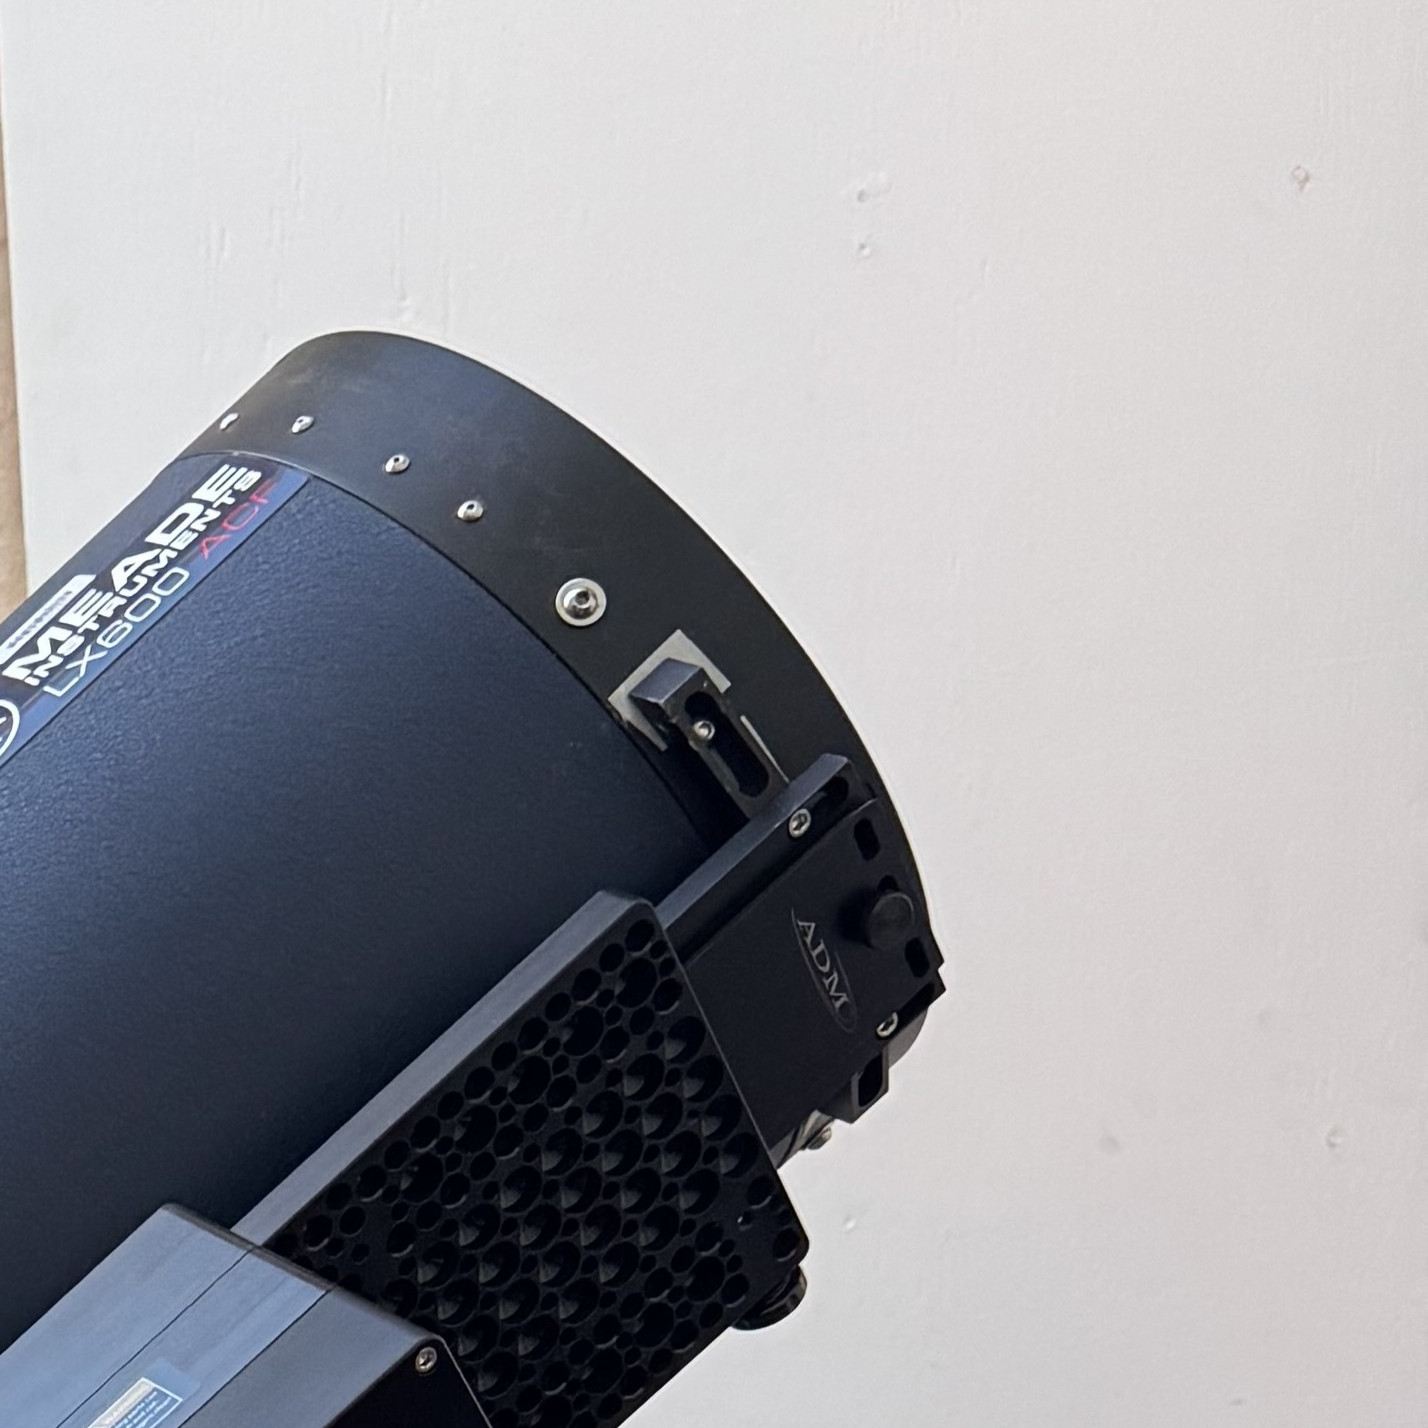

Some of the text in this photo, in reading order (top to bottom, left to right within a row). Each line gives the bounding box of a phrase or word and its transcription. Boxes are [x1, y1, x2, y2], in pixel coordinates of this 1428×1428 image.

[2, 464, 246, 682] MEADE
[24, 467, 262, 686] INSTRUMENTS
[44, 566, 190, 697] LX600
[199, 479, 275, 560] ACF
[797, 919, 848, 1012] ADM
